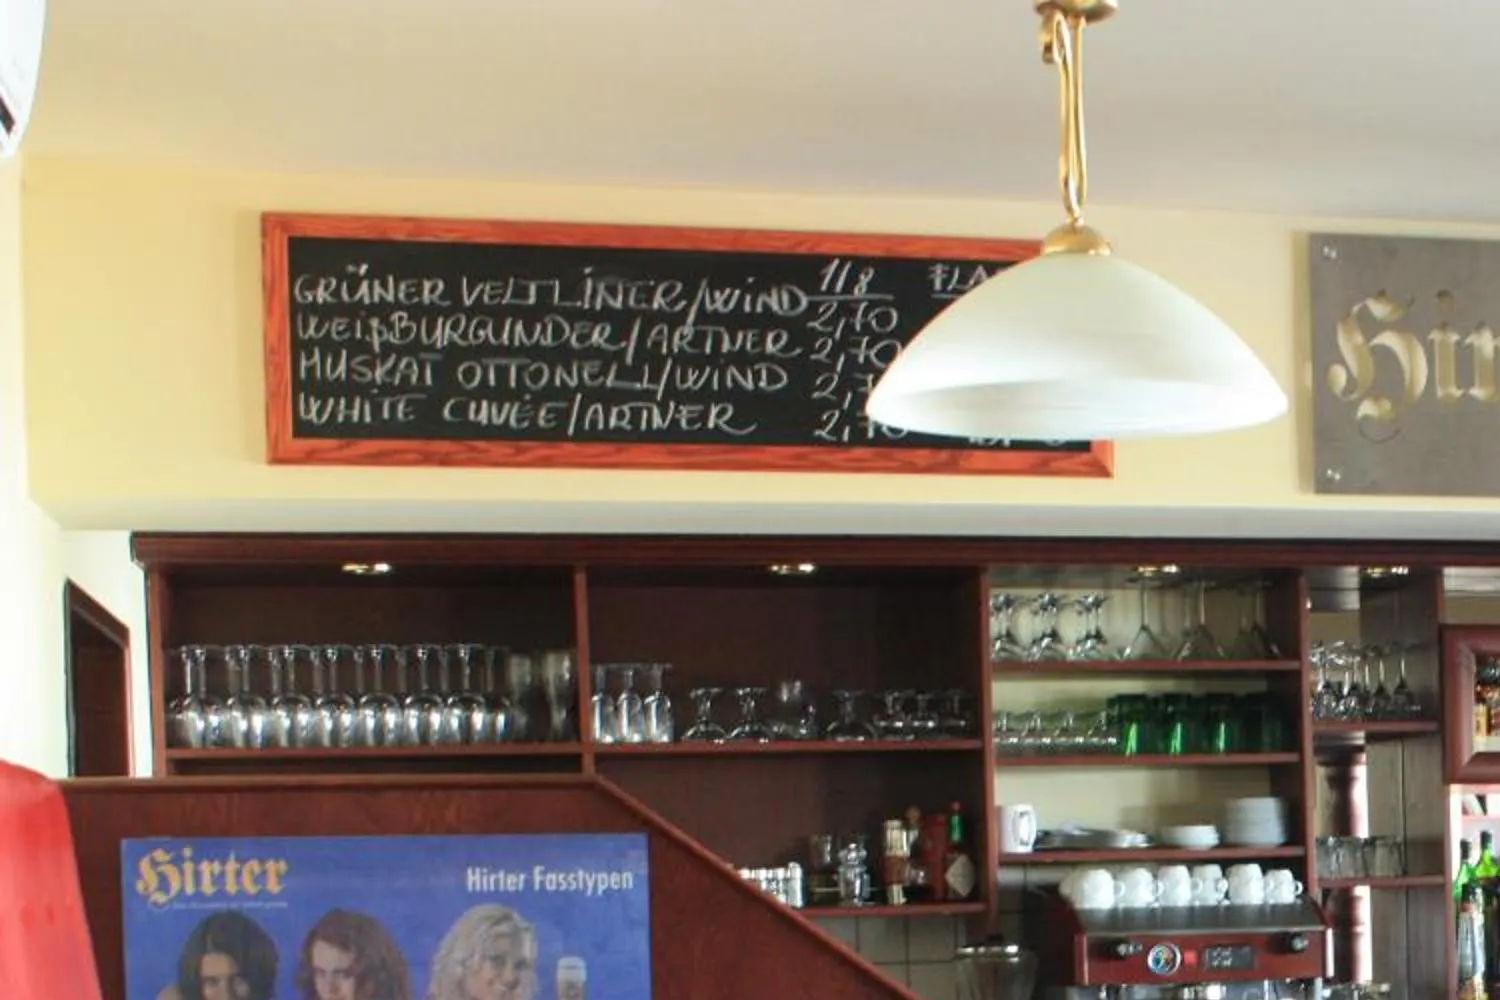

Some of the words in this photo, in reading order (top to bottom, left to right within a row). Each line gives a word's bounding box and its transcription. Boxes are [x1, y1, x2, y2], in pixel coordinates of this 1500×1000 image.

[294, 263, 452, 308] GRÜNER
[806, 301, 899, 341] 2,70
[299, 347, 444, 388] MUSKAT
[811, 373, 876, 411] 2,7
[299, 387, 428, 425] WHITE
[136, 847, 289, 907] Hirter
[466, 865, 526, 893] Hirter
[532, 864, 634, 897] Fasstypen
